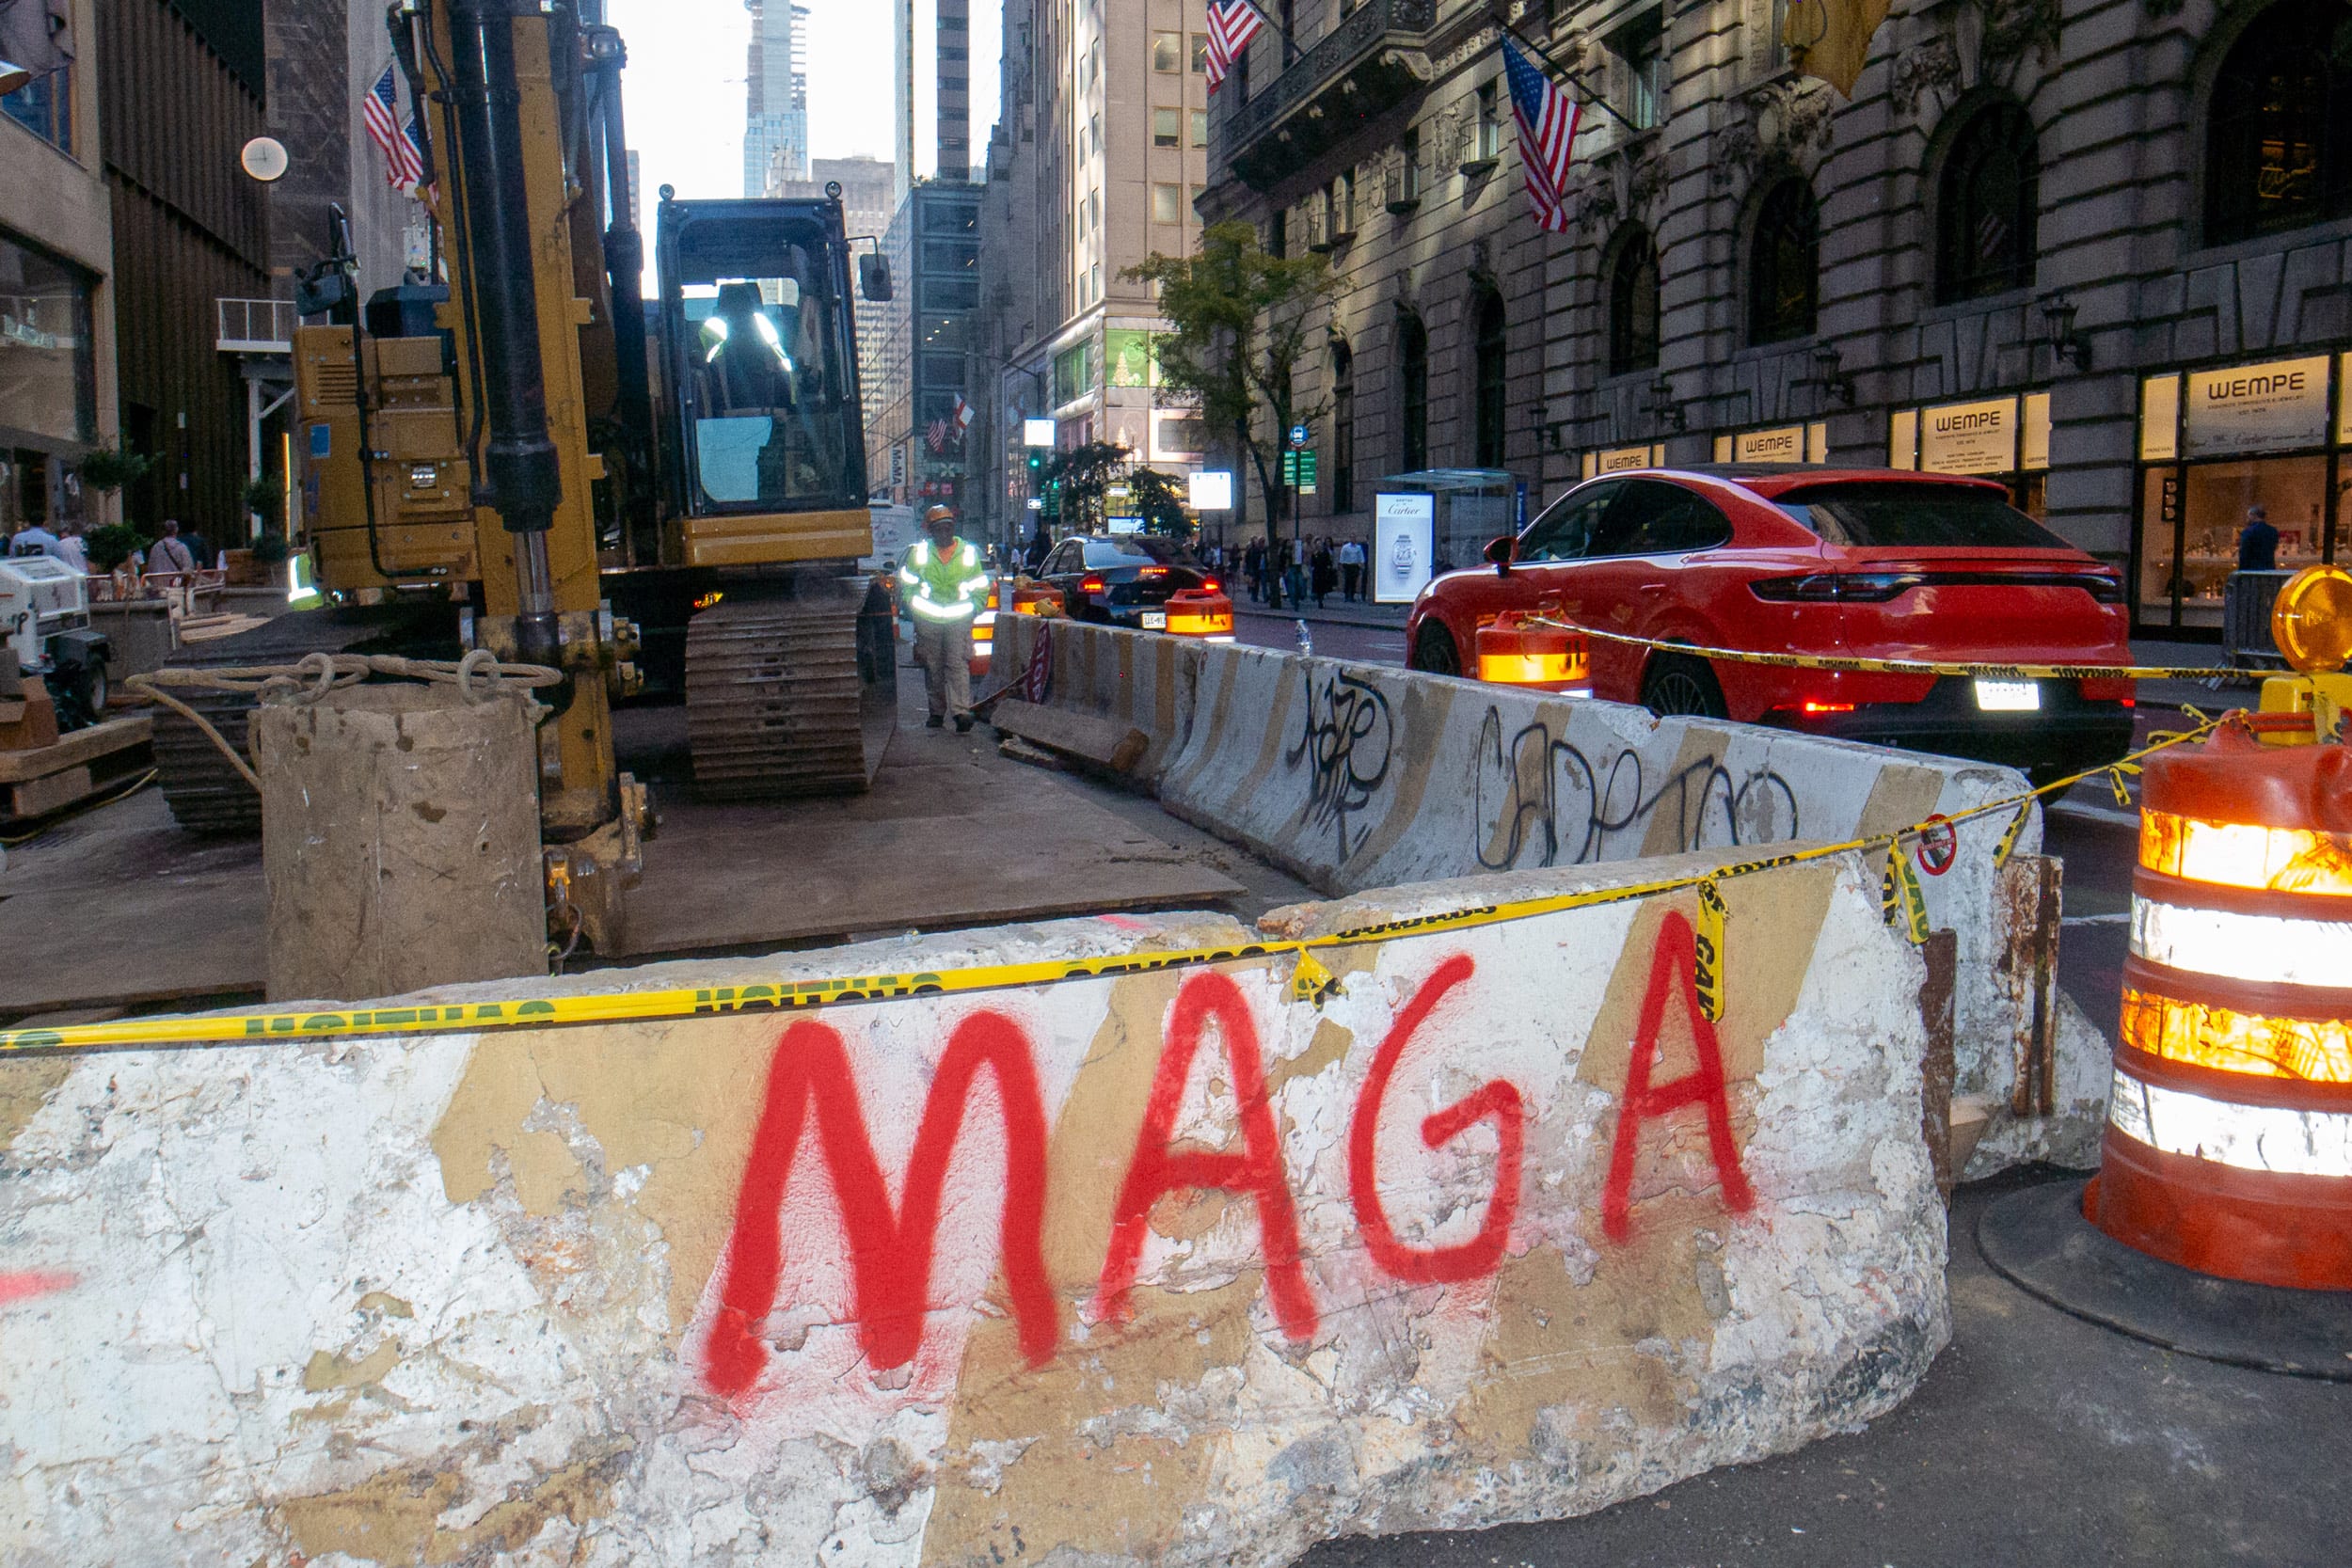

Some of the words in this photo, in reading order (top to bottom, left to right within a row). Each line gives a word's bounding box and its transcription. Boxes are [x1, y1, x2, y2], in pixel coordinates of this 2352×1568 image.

[2207, 372, 2305, 401] WEMPE
[1936, 411, 2001, 433] WEMPE
[1746, 436, 1793, 453] WEMPE
[893, 449, 902, 485] MoMA
[1606, 454, 1642, 470] WEMPE
[1388, 503, 1422, 515] Cartier
[698, 909, 1759, 1398] MAGA
